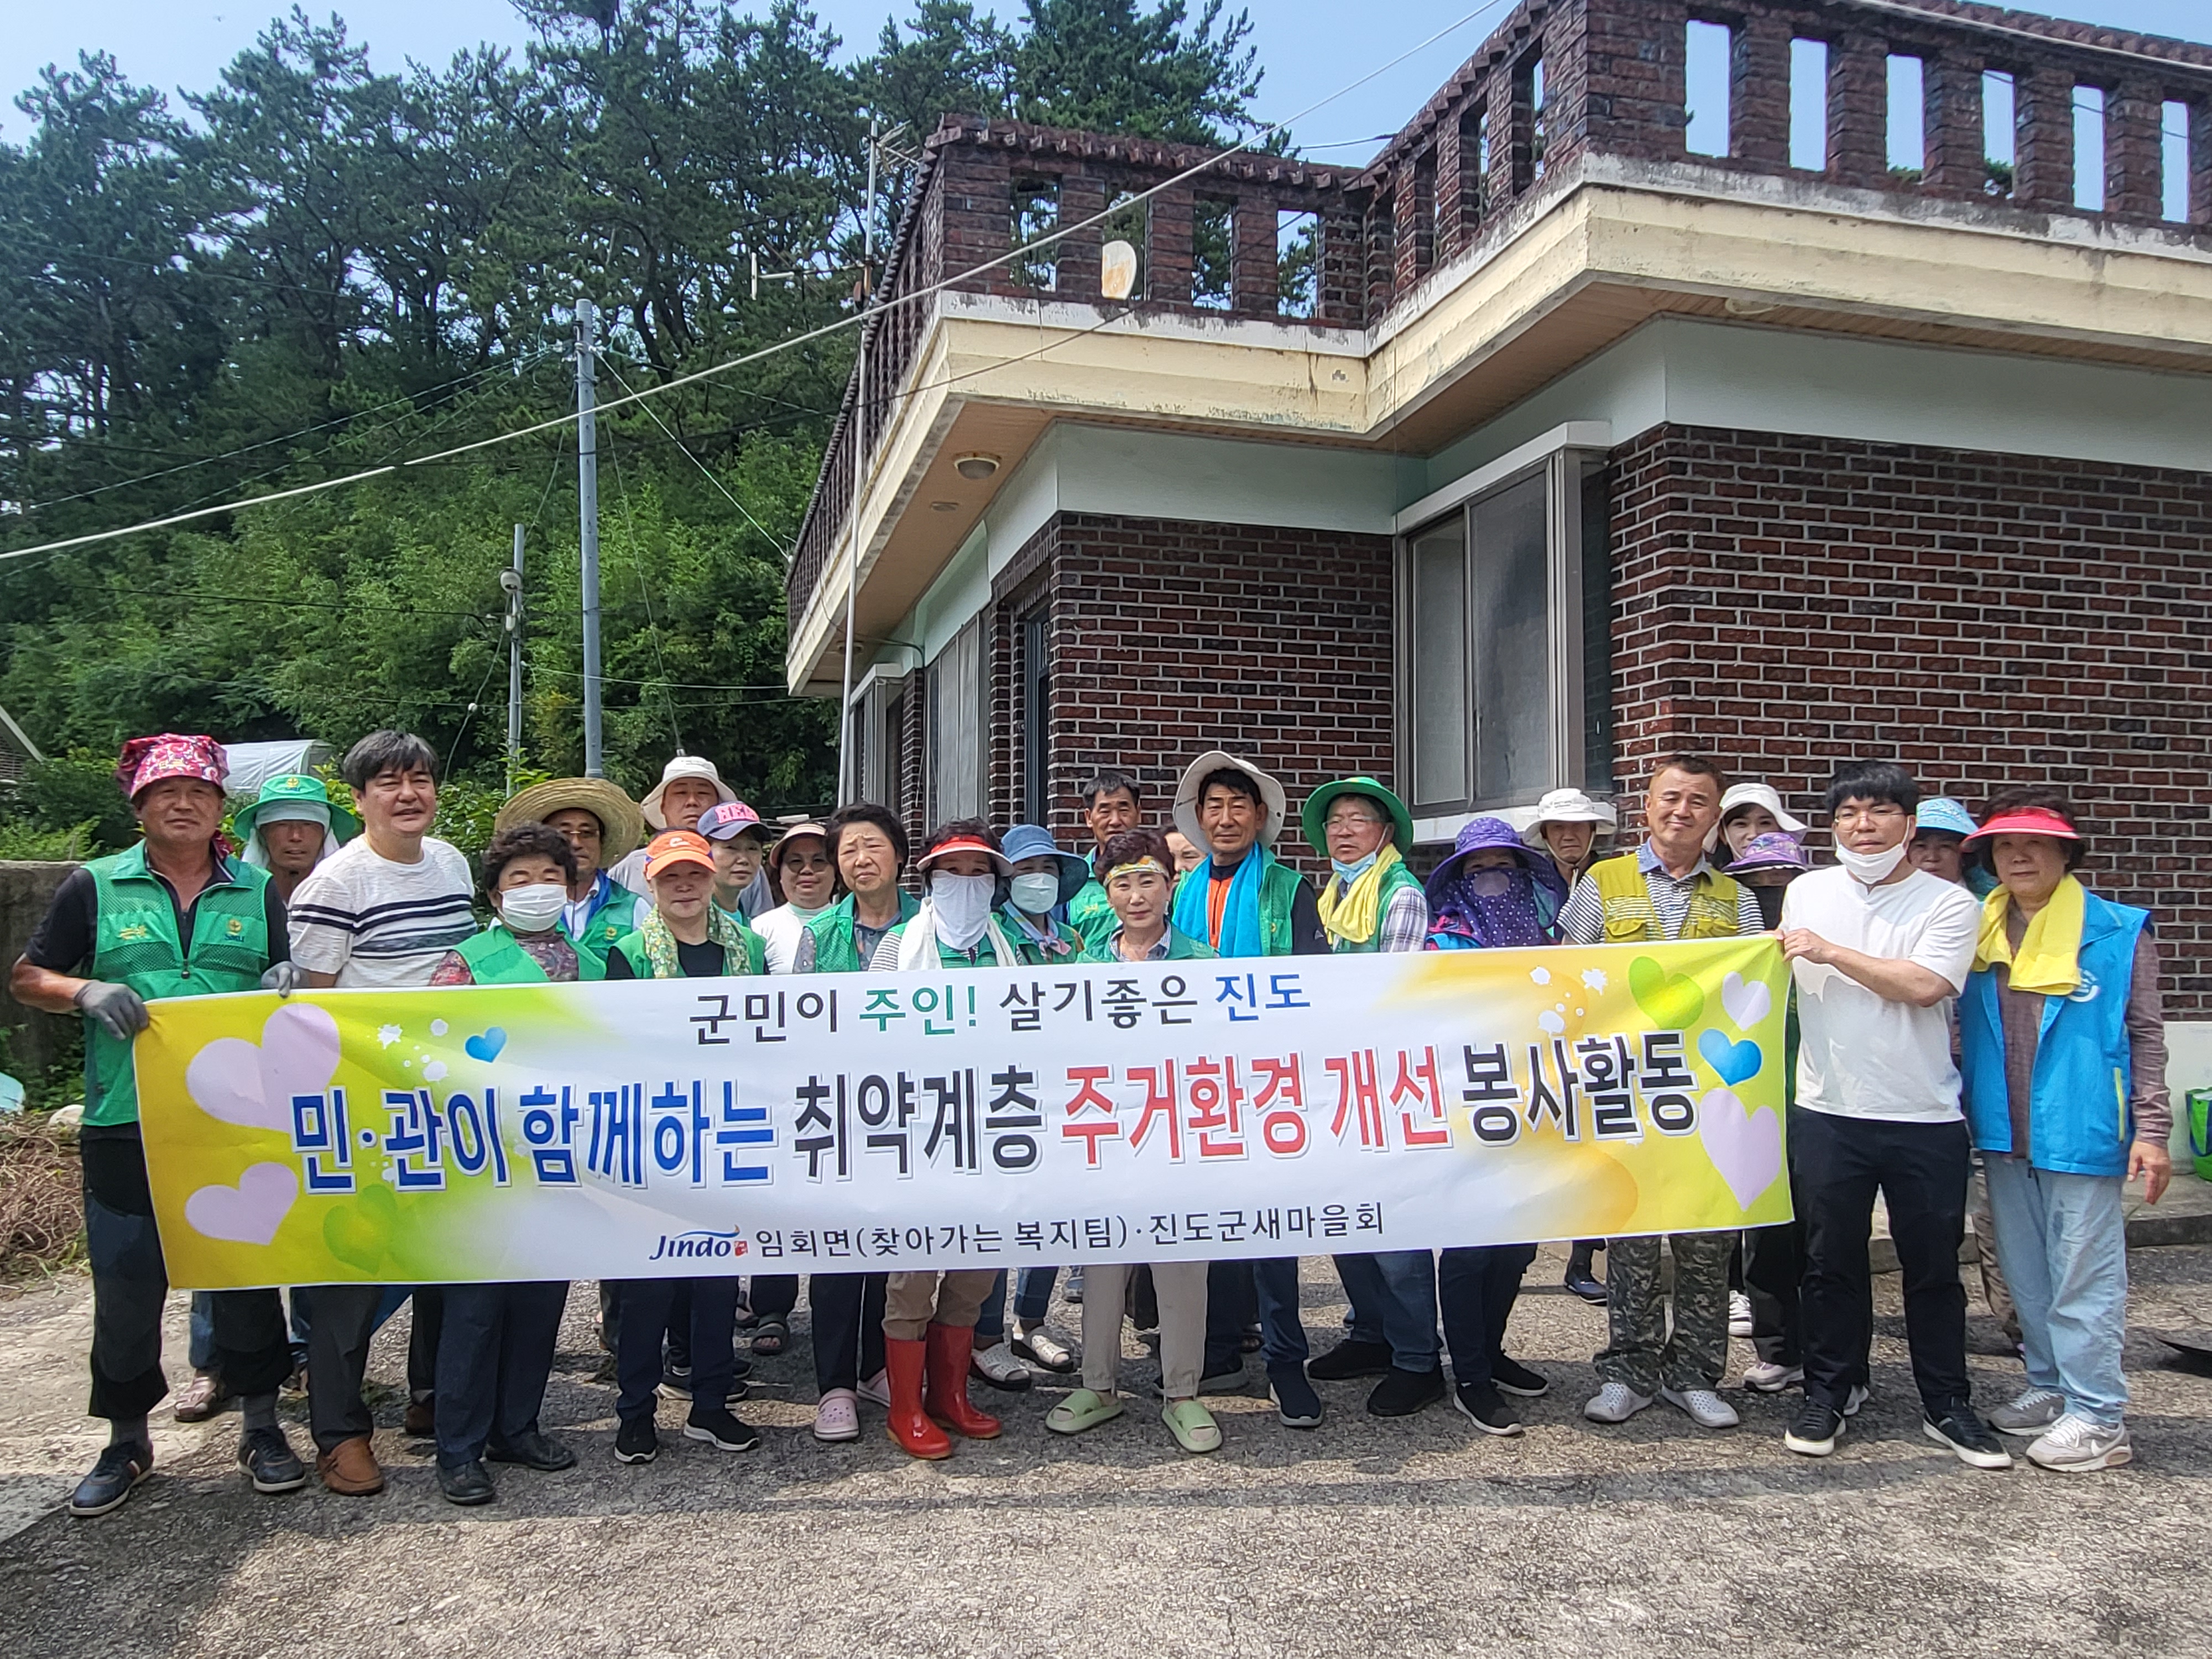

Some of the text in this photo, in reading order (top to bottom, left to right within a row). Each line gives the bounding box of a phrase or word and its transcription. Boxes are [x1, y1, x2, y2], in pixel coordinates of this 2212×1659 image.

[689, 973, 1311, 1045] 군민이 주인! 살기좋은 진도
[291, 1032, 1695, 1190] 민·관이 함께하는 취약계층 주거환경 개선 봉사활동
[649, 1235, 732, 1260] Jindo
